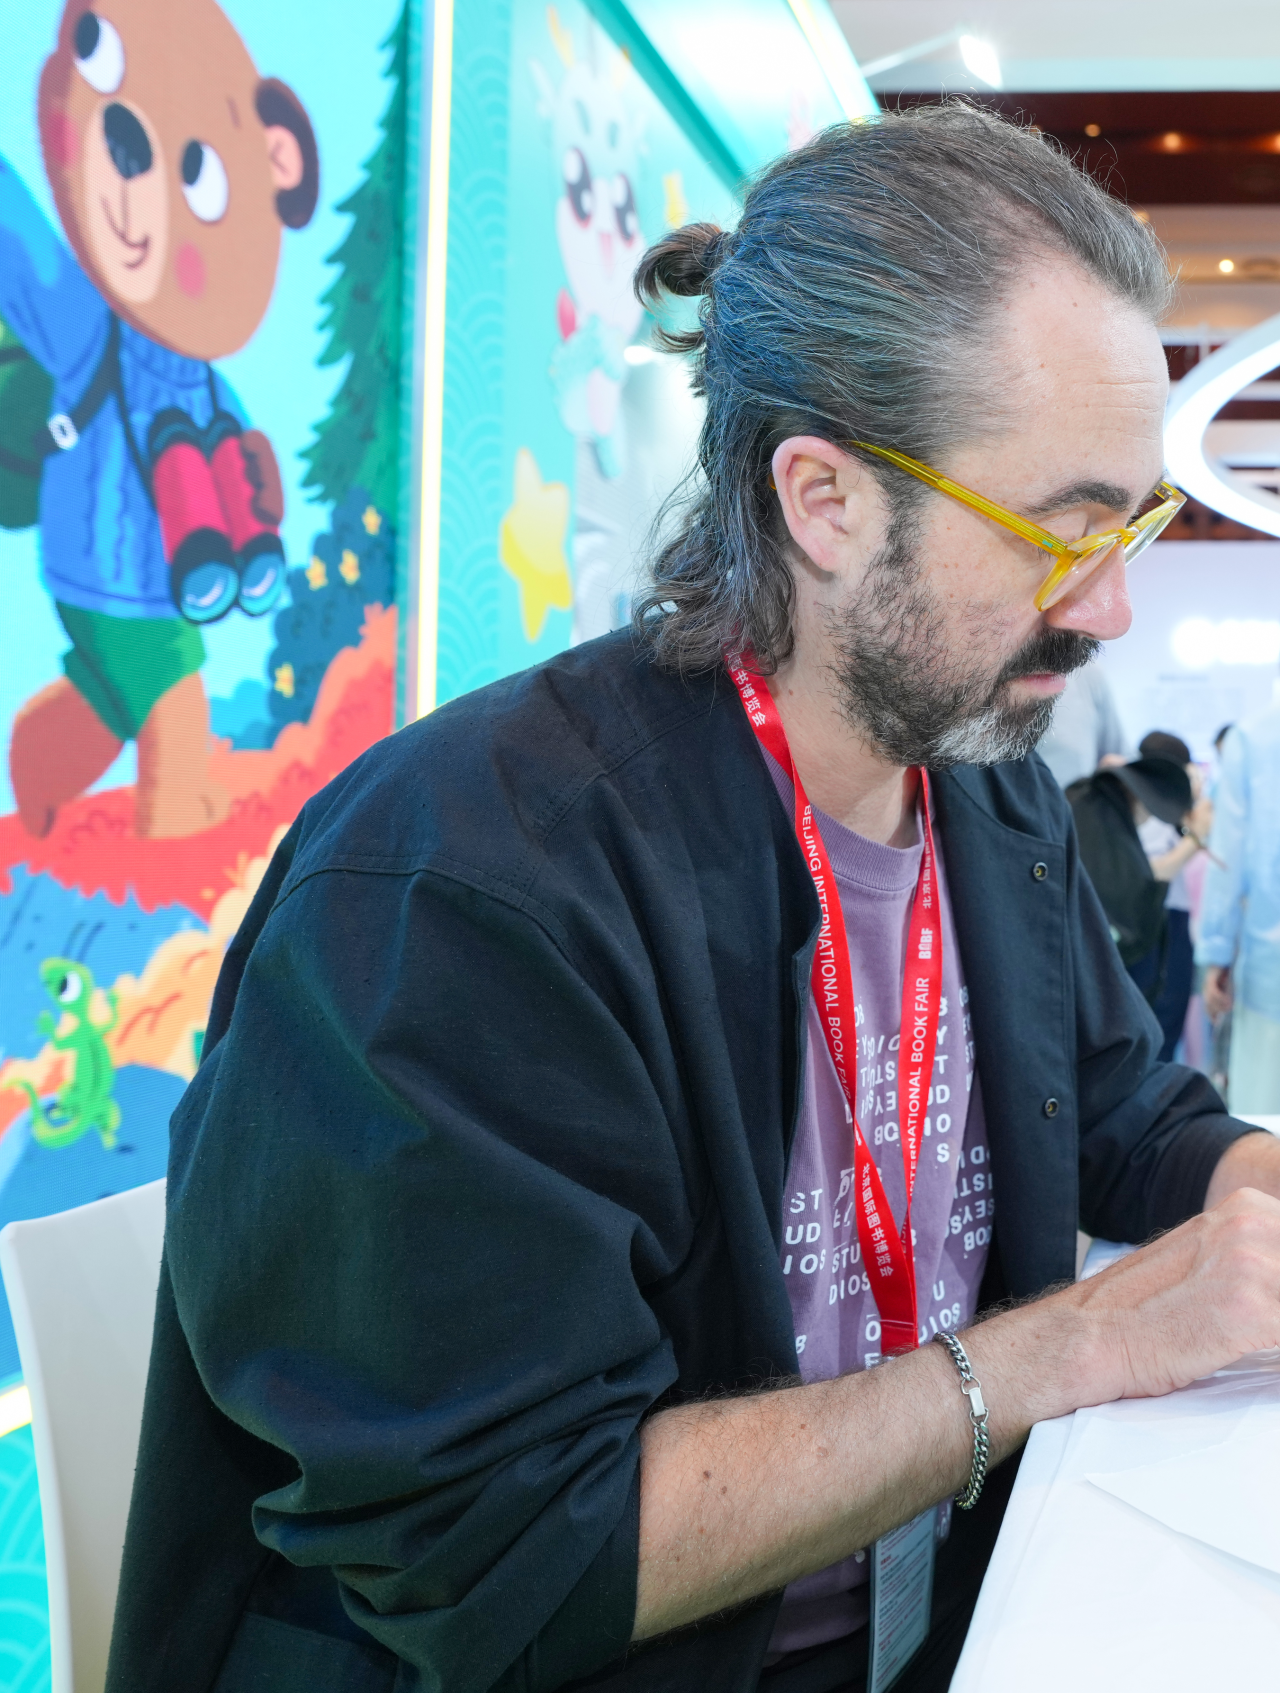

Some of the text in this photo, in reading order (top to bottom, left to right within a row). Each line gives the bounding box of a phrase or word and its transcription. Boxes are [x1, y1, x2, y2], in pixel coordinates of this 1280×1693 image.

[802, 804, 822, 872] BEIJING
[813, 875, 838, 1012] INTERNATIONAL
[828, 1016, 845, 1063] BOOK
[908, 977, 929, 1196] INTERNATIONAL BOOK FAIR
[862, 1162, 894, 1278] 北京国际图书博览会
